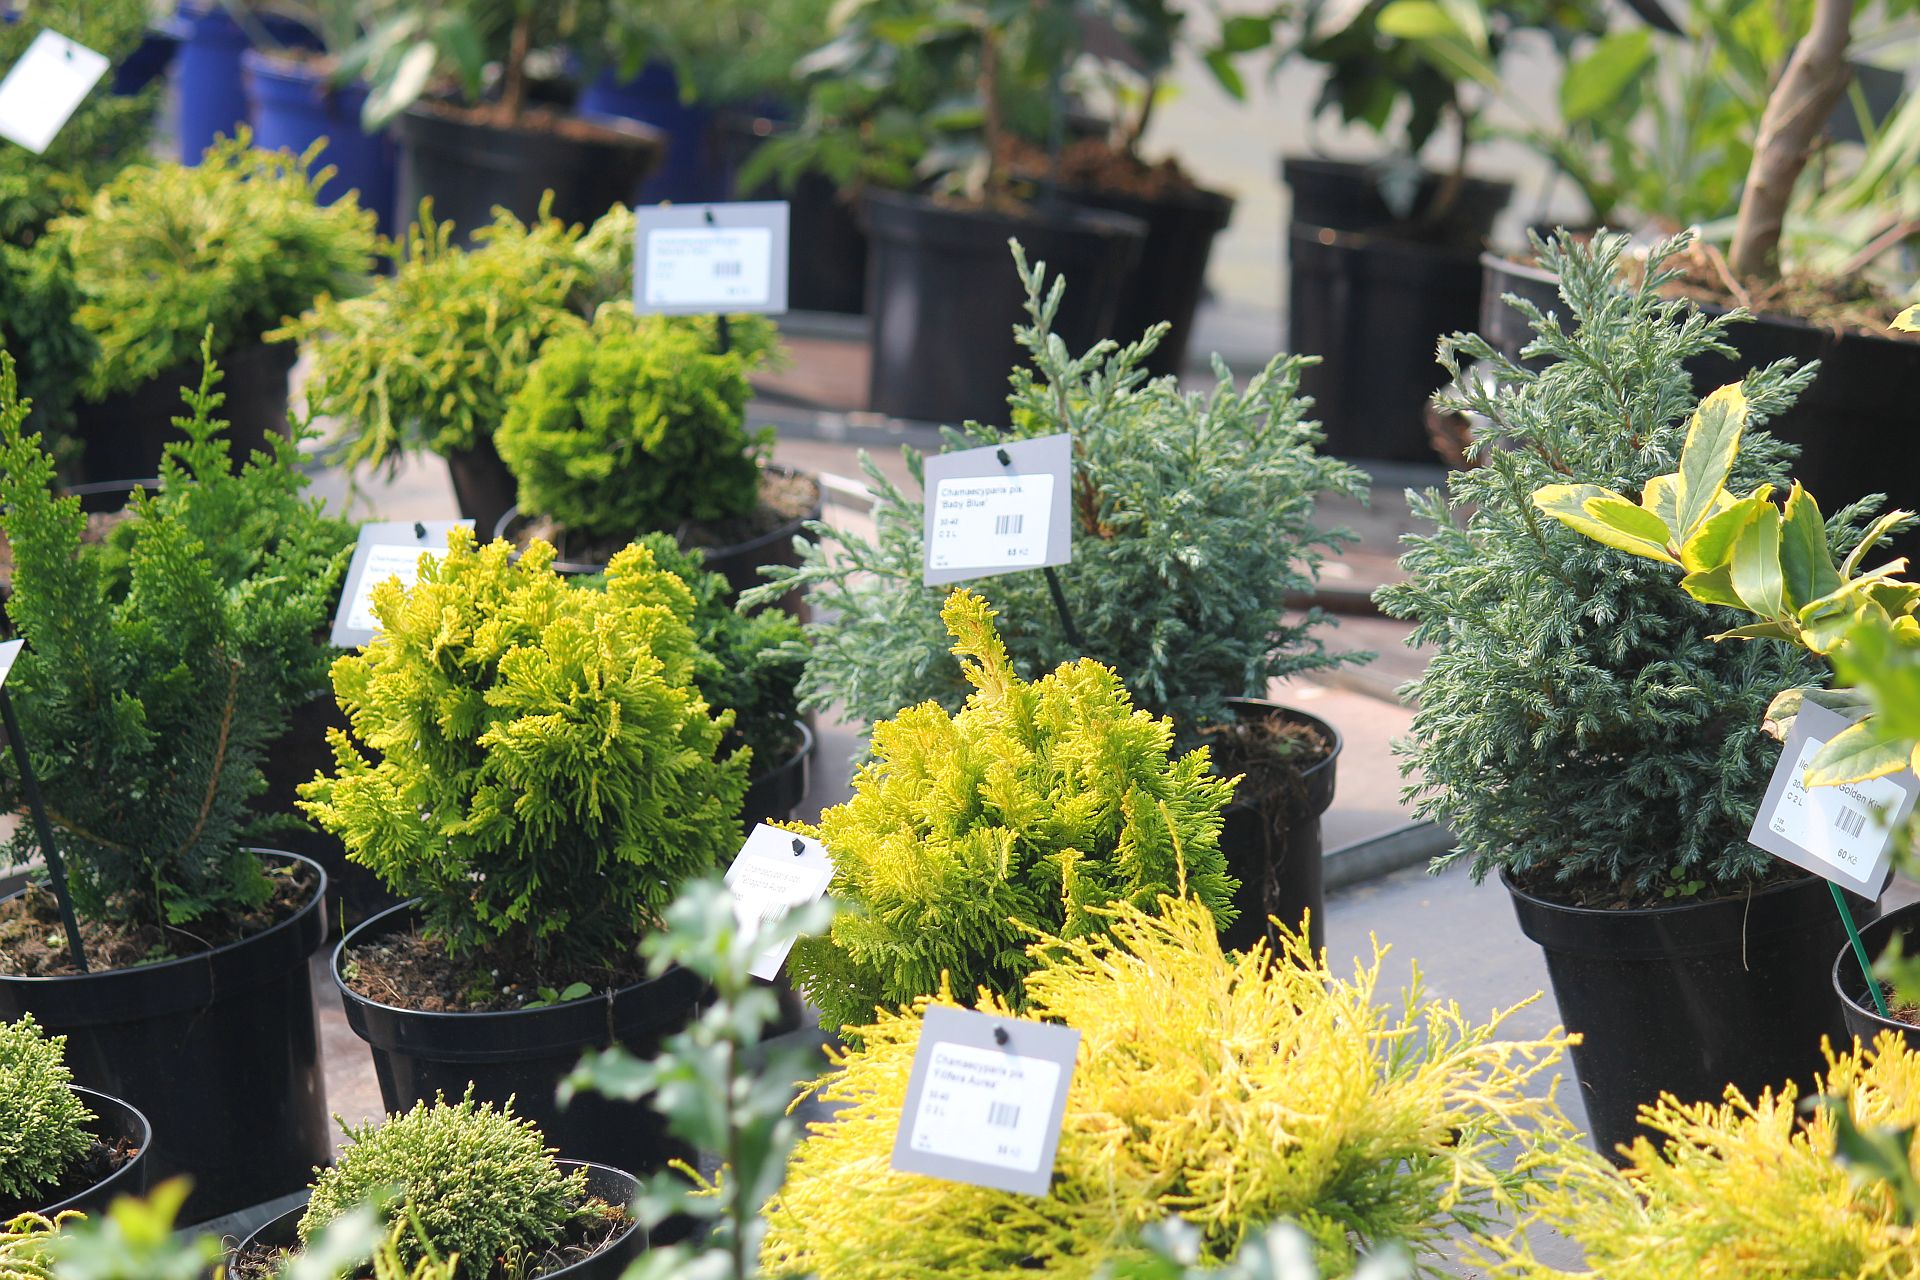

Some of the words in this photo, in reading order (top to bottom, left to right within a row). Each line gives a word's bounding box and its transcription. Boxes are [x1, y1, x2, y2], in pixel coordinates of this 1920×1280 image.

[1787, 792, 1793, 800] C
[1793, 795, 1798, 803] 2
[1798, 799, 1803, 807] L
[1837, 848, 1848, 859] 60
